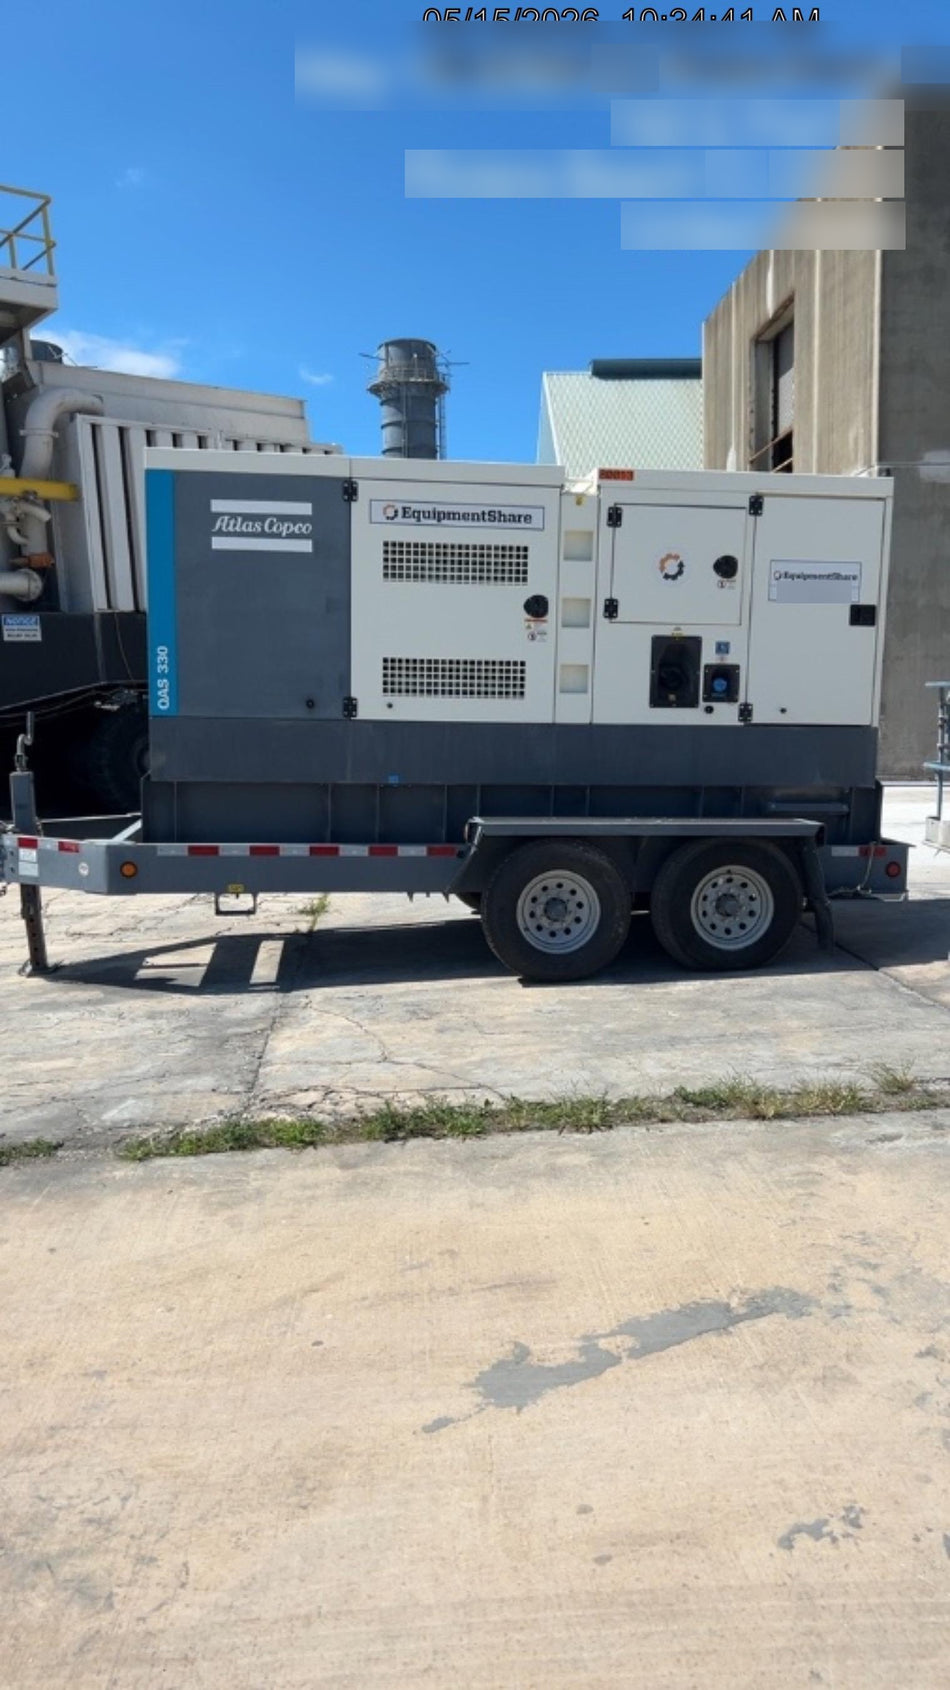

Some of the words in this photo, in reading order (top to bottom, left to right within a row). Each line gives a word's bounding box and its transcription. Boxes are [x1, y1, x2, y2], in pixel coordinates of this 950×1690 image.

[211, 515, 262, 532] Atlas
[264, 517, 312, 537] Copco
[401, 506, 532, 524] EquipmentShare
[784, 571, 858, 581] EquipmentShare
[157, 646, 168, 674] 330
[157, 679, 169, 710] QAS
